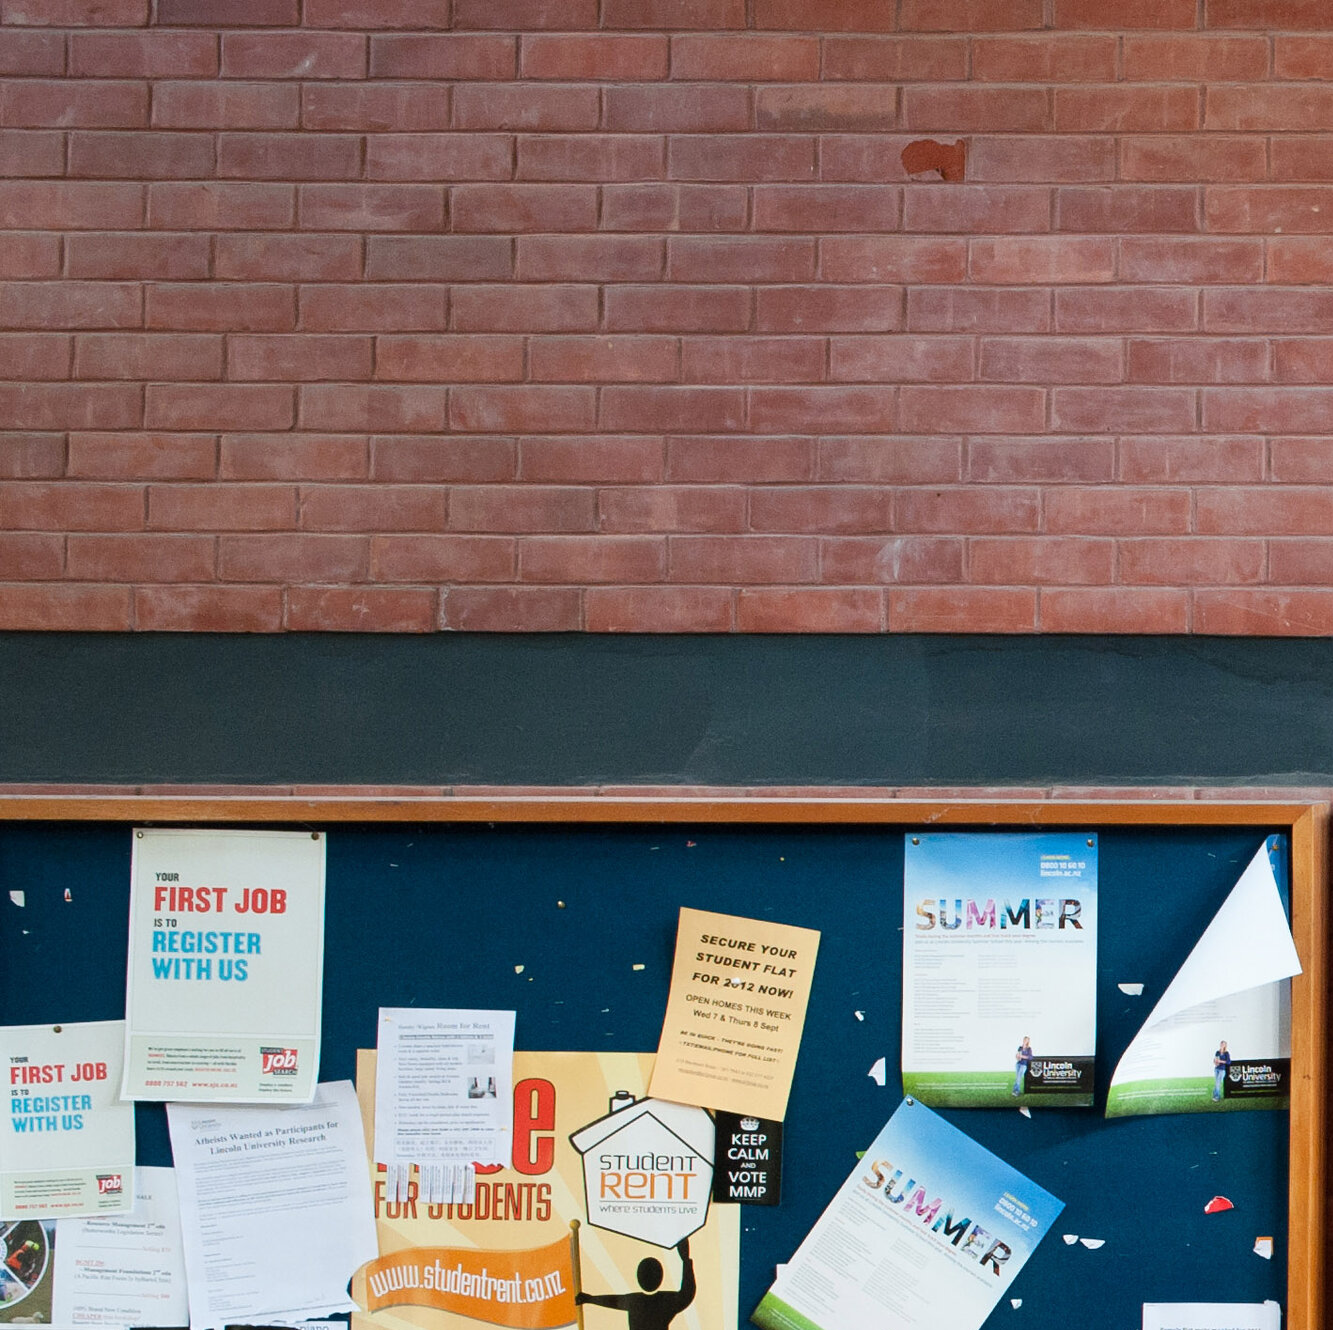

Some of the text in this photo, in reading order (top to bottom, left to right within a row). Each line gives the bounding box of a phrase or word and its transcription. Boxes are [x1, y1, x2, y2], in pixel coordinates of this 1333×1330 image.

[155, 872, 179, 882] YOUR
[154, 886, 287, 914] FIRST JOB
[154, 918, 177, 928] IS TO
[915, 899, 1083, 930] SUMMER
[152, 930, 261, 954] REGISTER
[700, 933, 798, 960] SECURE YOUR
[152, 958, 248, 981] WITH US
[696, 952, 797, 978] STUDENT FLAT
[691, 972, 795, 1000] FOR 2012 NOW!
[685, 993, 793, 1021] OPEN HOMES THIS WEEK
[264, 1051, 297, 1073] job
[1043, 1061, 1073, 1070] Lincoln
[1043, 1069, 1082, 1078] University
[194, 1135, 227, 1146] Atheists
[229, 1130, 262, 1141] Wanted
[275, 1123, 325, 1136] Participants
[327, 1120, 338, 1129] for
[210, 1133, 326, 1155] Lincoln University Research
[731, 1133, 767, 1146] KEEP
[727, 1148, 769, 1161] CALM
[728, 1171, 767, 1184] VOTE
[729, 1185, 767, 1198] MMP
[862, 1159, 1012, 1277] SUMMER
[369, 1259, 566, 1304] www.studentrent.co.nz
